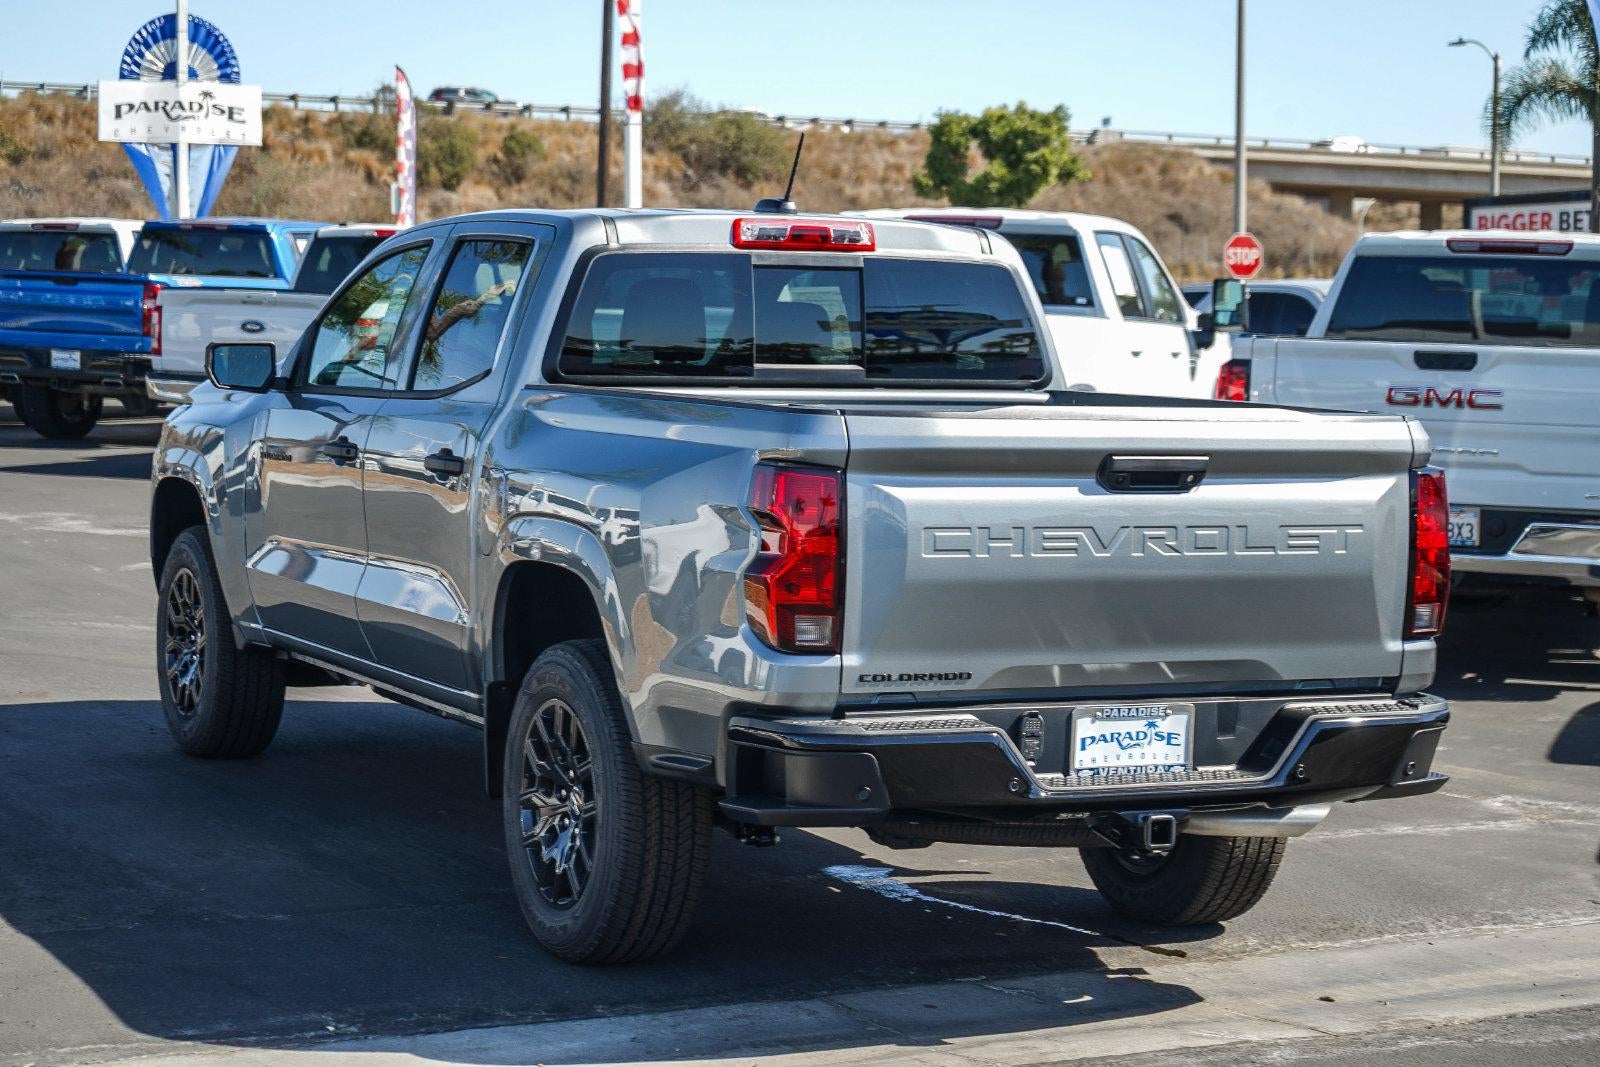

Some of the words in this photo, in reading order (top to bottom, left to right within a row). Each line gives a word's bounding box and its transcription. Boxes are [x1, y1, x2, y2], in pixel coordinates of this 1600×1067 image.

[114, 91, 246, 124] PARADISE
[114, 125, 247, 141] CHEVROLET
[1477, 212, 1552, 231] BIGGER
[1227, 247, 1259, 265] STOP
[1386, 386, 1504, 410] GMC
[921, 525, 1364, 558] CHEVROLET
[858, 672, 972, 683] COLORADO
[1103, 707, 1167, 718] PARADISE
[1080, 720, 1181, 751] PARADISE
[1079, 752, 1181, 767] CHEVROLET
[1099, 766, 1165, 777] VENTURA
